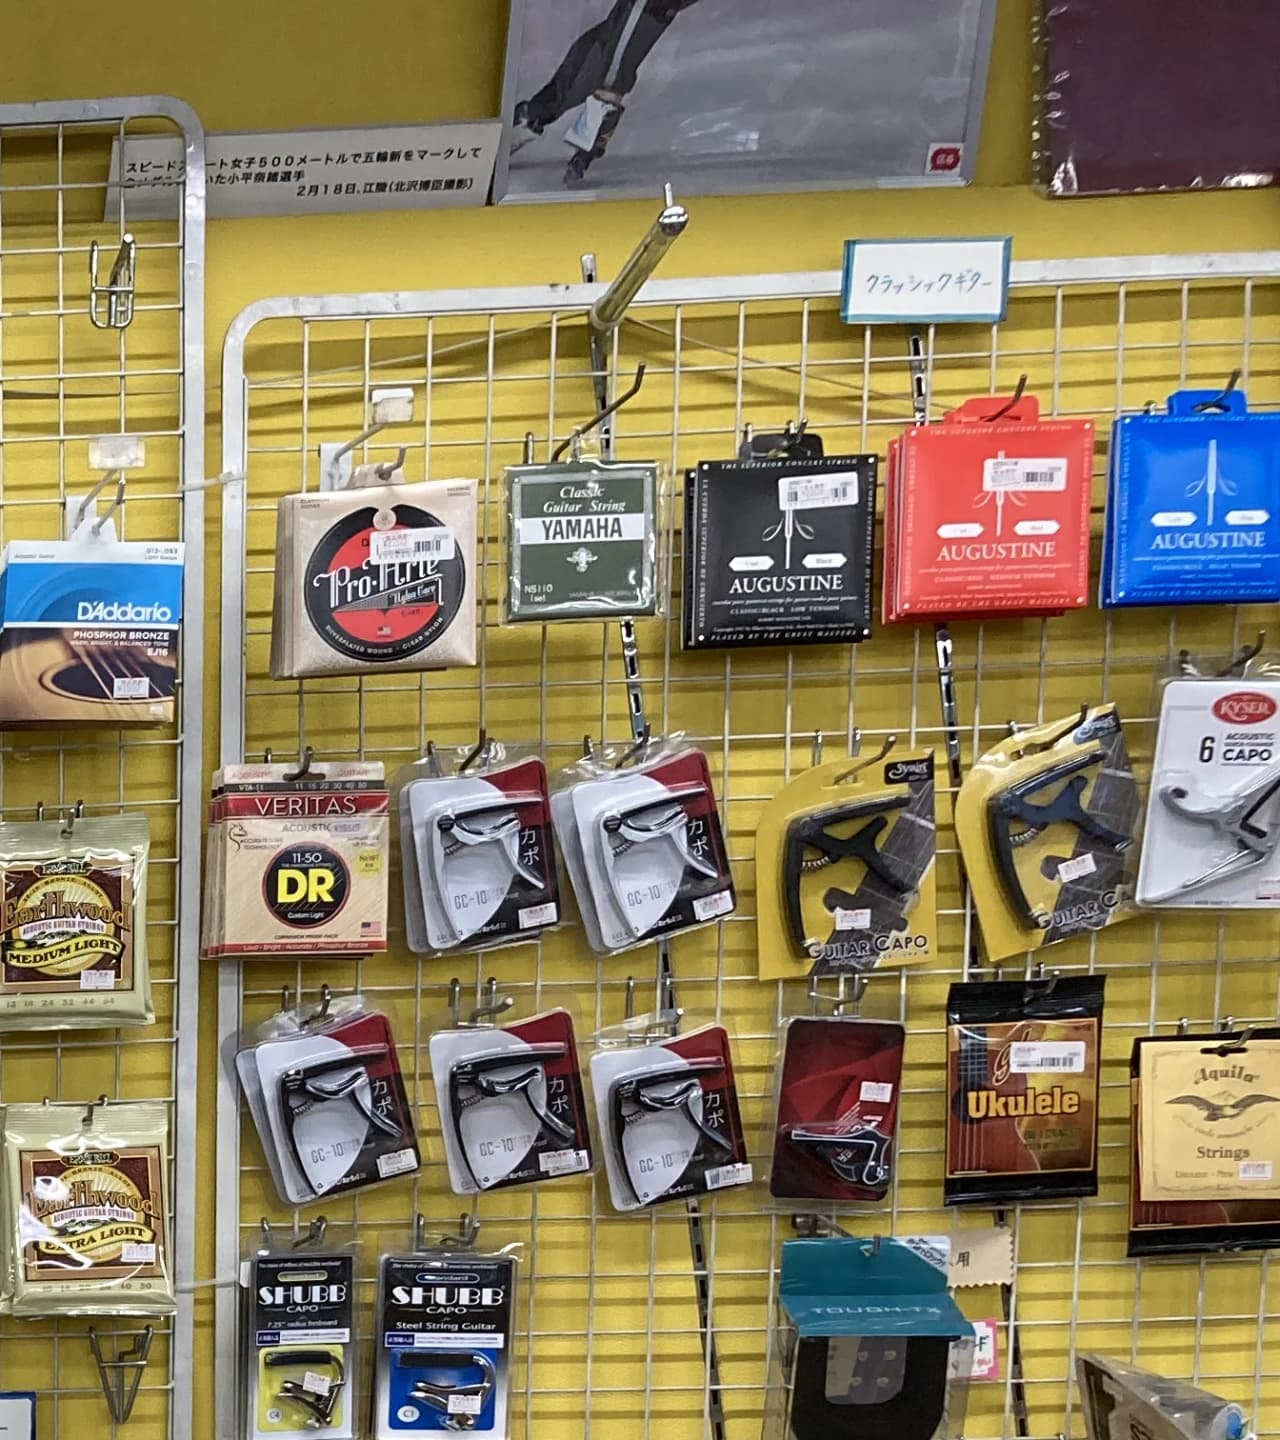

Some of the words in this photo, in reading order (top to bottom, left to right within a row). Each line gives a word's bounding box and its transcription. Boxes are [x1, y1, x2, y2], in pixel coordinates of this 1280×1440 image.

[560, 484, 605, 499] Classic
[544, 500, 579, 515] Guitar
[590, 500, 626, 513] String
[541, 517, 623, 540] YAMAHA
[729, 575, 843, 594] AUGUSTINE
[73, 631, 127, 641] PHOSPHOR
[129, 631, 169, 641] BRONZE
[147, 648, 169, 657] EJ16
[1220, 696, 1271, 722] KYSER
[1222, 749, 1273, 762] CAPO
[255, 796, 357, 817] VERITAS
[520, 830, 541, 866] カポ
[277, 871, 336, 903] DR
[454, 889, 488, 909] GC-10
[0, 889, 131, 937] Earthwood
[8, 946, 72, 967] MEDIUM
[74, 937, 120, 956] LIGHT
[808, 939, 872, 962] GUITAR
[875, 934, 928, 951] CAPO
[1194, 1066, 1256, 1085] Aquila
[967, 1087, 1080, 1119] Ukulele
[1197, 1144, 1251, 1160] Strings
[396, 1321, 422, 1330] Steel
[426, 1321, 458, 1332] String
[461, 1321, 496, 1330] Guitar
